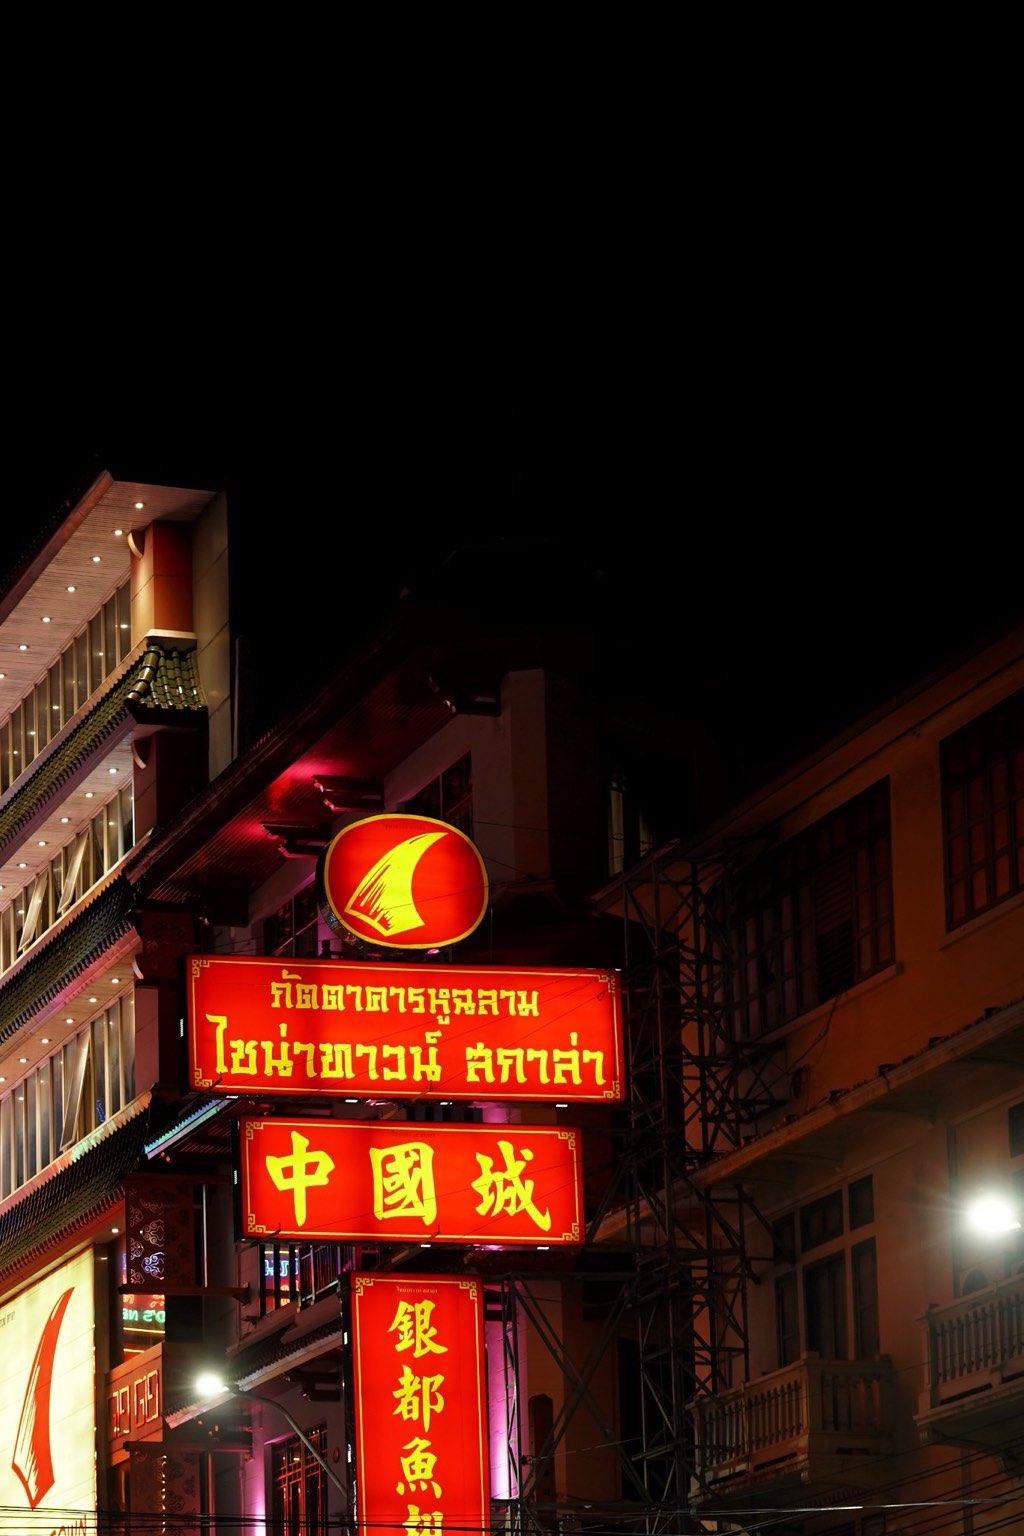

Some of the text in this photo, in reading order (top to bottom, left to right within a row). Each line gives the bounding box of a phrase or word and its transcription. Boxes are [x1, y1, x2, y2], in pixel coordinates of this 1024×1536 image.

[270, 969, 540, 1025] ภัตตาคารหูฉลาม
[205, 1014, 607, 1086] ไชน่าทาวน์ สกาล่า
[265, 1130, 552, 1232] 中國城
